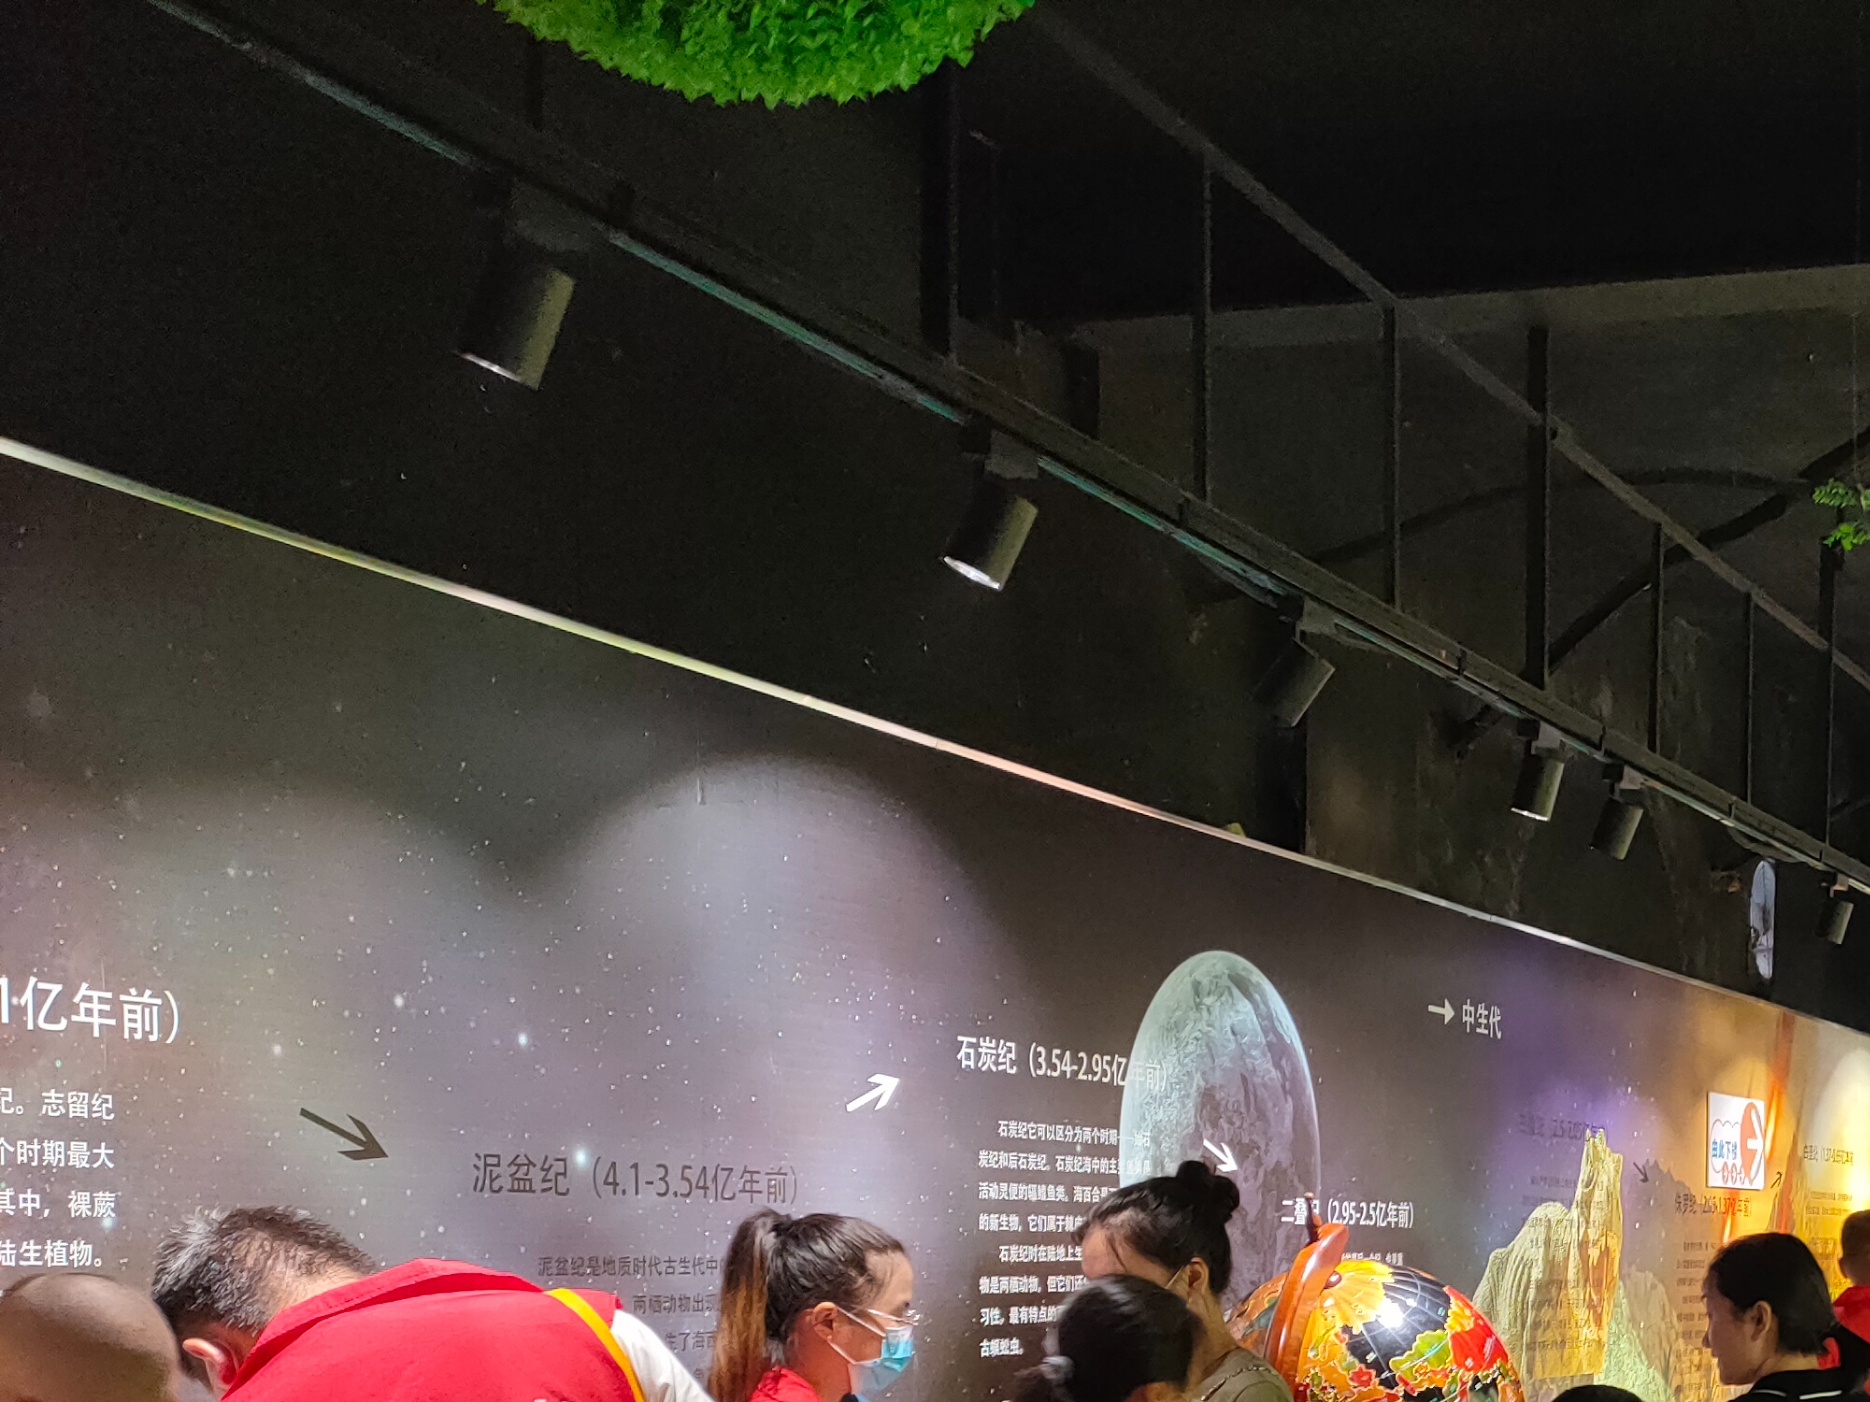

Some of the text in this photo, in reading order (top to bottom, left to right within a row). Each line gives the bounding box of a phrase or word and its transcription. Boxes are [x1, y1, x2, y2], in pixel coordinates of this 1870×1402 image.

[1462, 999, 1502, 1040] 中生代
[537, 1254, 723, 1278] 泥盆纪是地质时代古生代中
